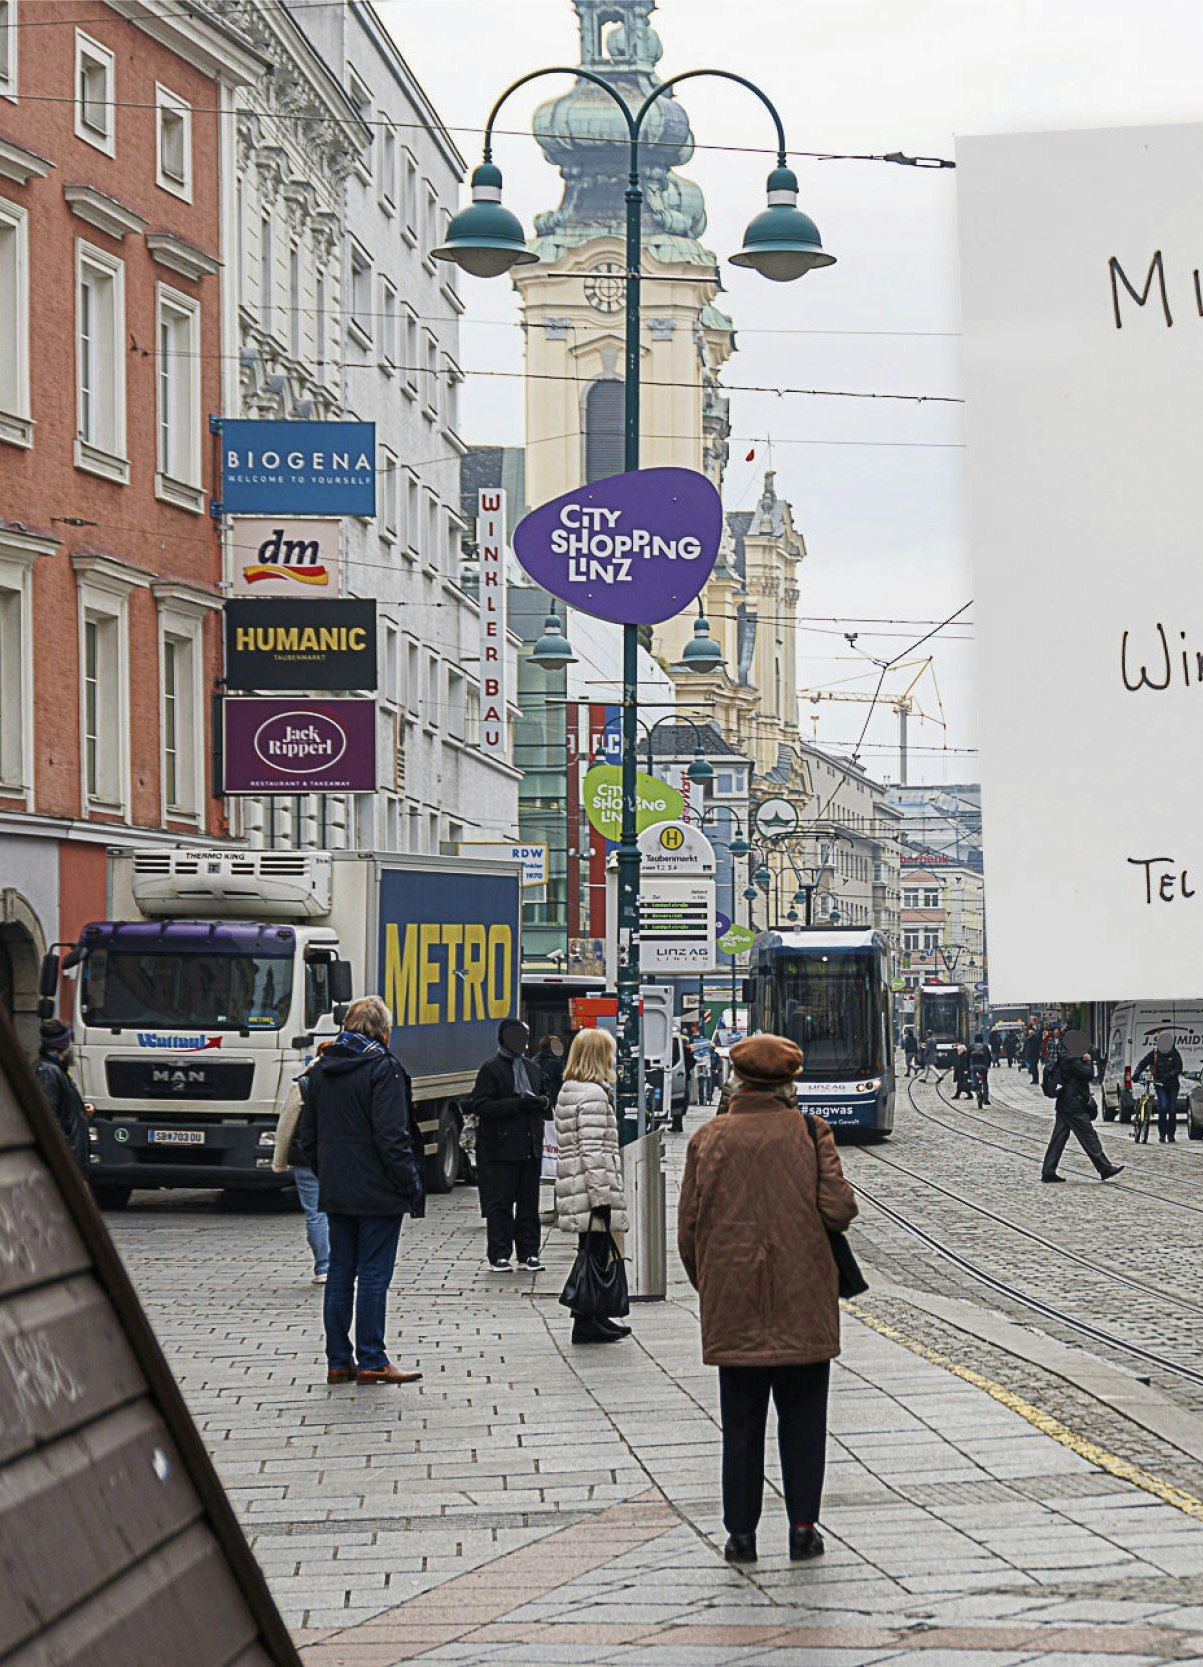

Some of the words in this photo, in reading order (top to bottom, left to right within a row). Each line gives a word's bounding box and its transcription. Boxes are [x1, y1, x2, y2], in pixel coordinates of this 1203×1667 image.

[227, 451, 371, 470] BIOGENA
[227, 475, 284, 484] WELCOME
[291, 475, 305, 484] TO
[311, 476, 371, 485] YOURSELF
[258, 529, 320, 565] dm
[481, 493, 501, 662] WINKLER
[235, 627, 368, 651] HUMANIC
[484, 678, 500, 747] BAU
[283, 725, 321, 743] Jack
[269, 739, 332, 758] Ripperl
[186, 852, 223, 860] THERMO
[224, 853, 245, 861] KING
[512, 848, 543, 858] RDW
[645, 854, 698, 862] Taubenmarkt
[689, 948, 708, 956] AG
[384, 923, 512, 1027] METRO
[152, 1070, 205, 1082] MAN
[800, 1105, 853, 1117] #sagwas
